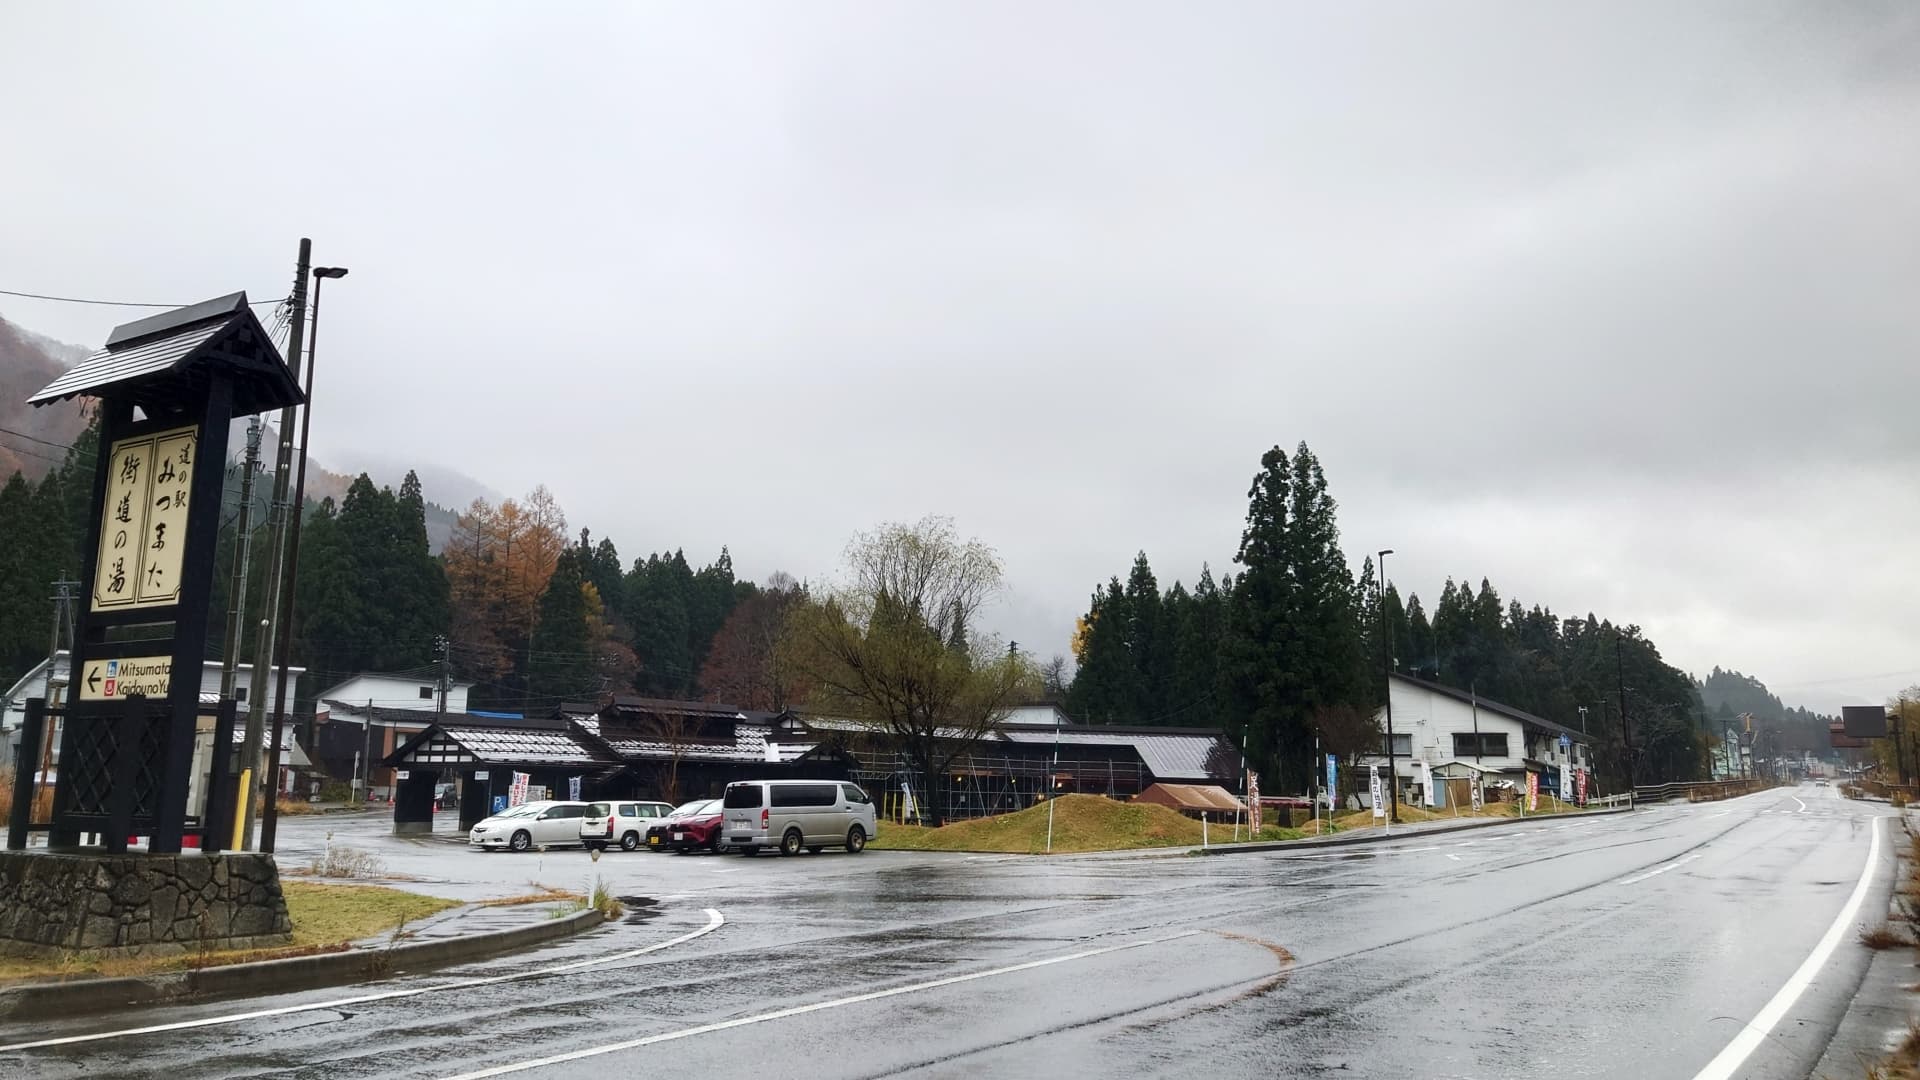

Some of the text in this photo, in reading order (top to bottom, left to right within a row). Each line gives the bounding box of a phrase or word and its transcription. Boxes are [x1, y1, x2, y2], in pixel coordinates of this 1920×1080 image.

[107, 453, 140, 594] 街道の湯
[147, 456, 175, 588] みつまた
[174, 443, 191, 508] 道の駅
[118, 662, 171, 677] Mitsumata
